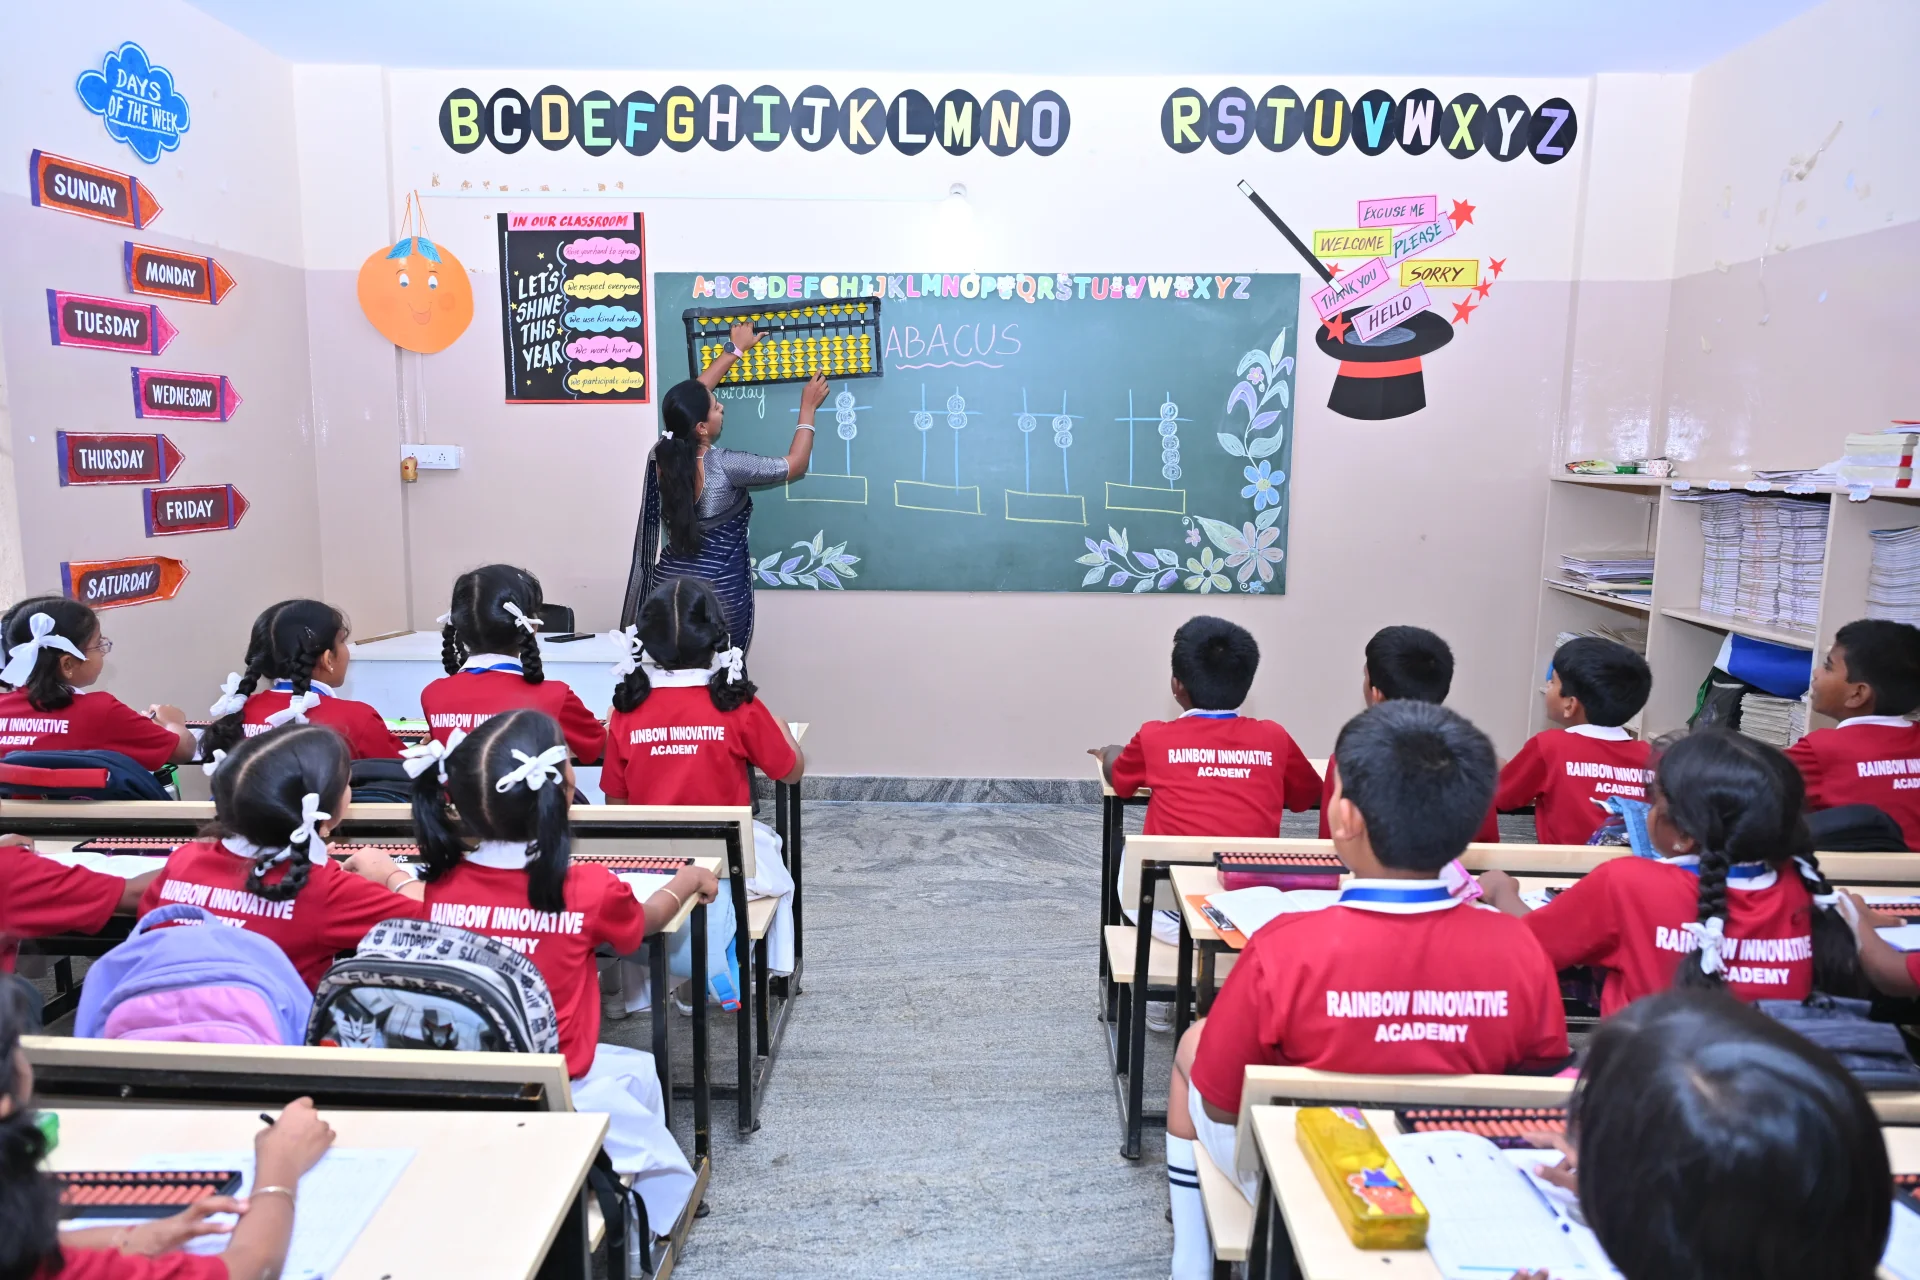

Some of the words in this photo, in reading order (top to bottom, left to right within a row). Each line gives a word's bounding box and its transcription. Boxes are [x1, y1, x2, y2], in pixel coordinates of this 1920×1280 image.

[116, 66, 161, 102] DAYS
[108, 96, 124, 119] OF
[126, 100, 149, 126] THE
[150, 105, 179, 133] WEEK
[54, 173, 117, 208] SUNDAY
[513, 216, 527, 227] IN
[531, 216, 556, 227] OUR
[560, 215, 628, 227] CLASSROOM
[1363, 205, 1407, 221] EXCUSE
[1409, 203, 1425, 217] ME
[1320, 236, 1385, 252] WELCOME
[1393, 222, 1442, 259] PLEASE
[145, 262, 197, 289] MONDAY
[518, 263, 560, 300] LET'S
[1410, 266, 1465, 283] SORRY
[579, 281, 605, 293] respect
[608, 283, 640, 292] everyone
[1320, 281, 1359, 310] THANK
[1357, 268, 1378, 289] YOU
[516, 293, 563, 323] SHINE
[597, 312, 616, 323] kind
[617, 314, 638, 323] words
[1369, 296, 1412, 331] HELLO
[74, 310, 140, 339] TUESDAY
[520, 318, 556, 345] THIS
[590, 344, 609, 354] work
[611, 344, 634, 353] hard
[885, 323, 1022, 359] ABACUS
[522, 340, 564, 372] YEAR
[152, 383, 213, 410] WEDNESDAY
[79, 448, 145, 470] THURSDAY
[166, 499, 214, 521] FRIDAY
[87, 571, 153, 599] SATURDAY
[9, 718, 69, 734] INNOVATIVE
[430, 713, 474, 728] RAINBOW
[630, 726, 669, 745] AINBOW
[669, 726, 725, 741] INNOVATIVE
[650, 745, 699, 756] ACADEMY
[1168, 748, 1216, 765] RAINBOW
[1217, 749, 1273, 767] INNOVATIVE
[1197, 766, 1252, 779] ACADEMY
[1566, 761, 1613, 779] RAINBOW
[1856, 761, 1908, 777] RAINBOW
[1595, 782, 1646, 797] ACADEMY
[208, 887, 296, 920] INNOVATIVE
[1739, 935, 1813, 962] INNOVATIVE
[1326, 990, 1411, 1018] RAINBOW
[1412, 990, 1508, 1018] INNOVATIVE
[1375, 1022, 1469, 1043] ACADEMY
